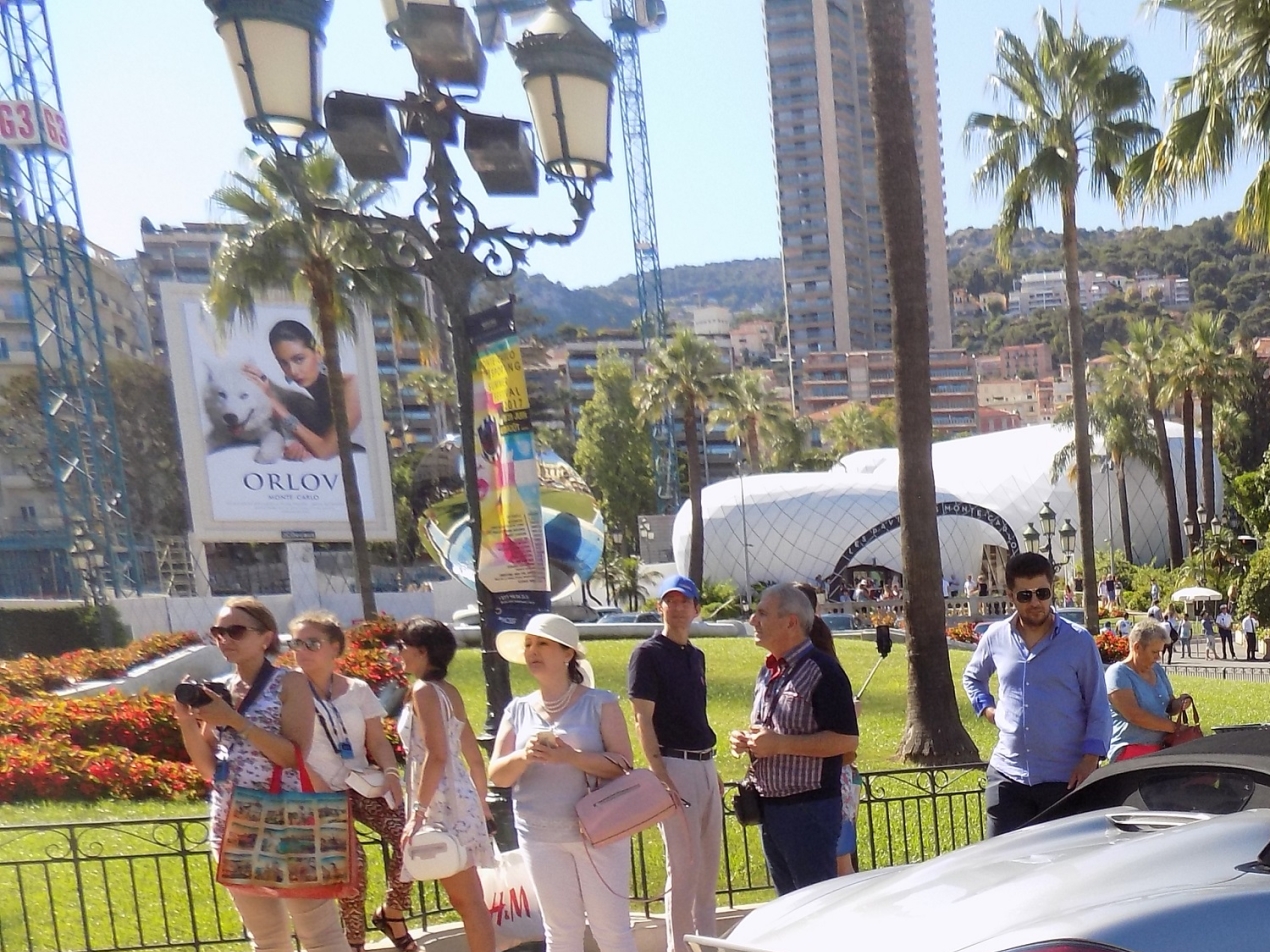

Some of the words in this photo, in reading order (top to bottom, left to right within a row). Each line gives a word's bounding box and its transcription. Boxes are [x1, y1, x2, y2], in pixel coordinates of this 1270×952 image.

[0, 104, 35, 139] G3
[43, 108, 70, 149] G3
[243, 472, 339, 491] ORLOV
[848, 534, 867, 555] LES
[488, 885, 531, 926] H&M
